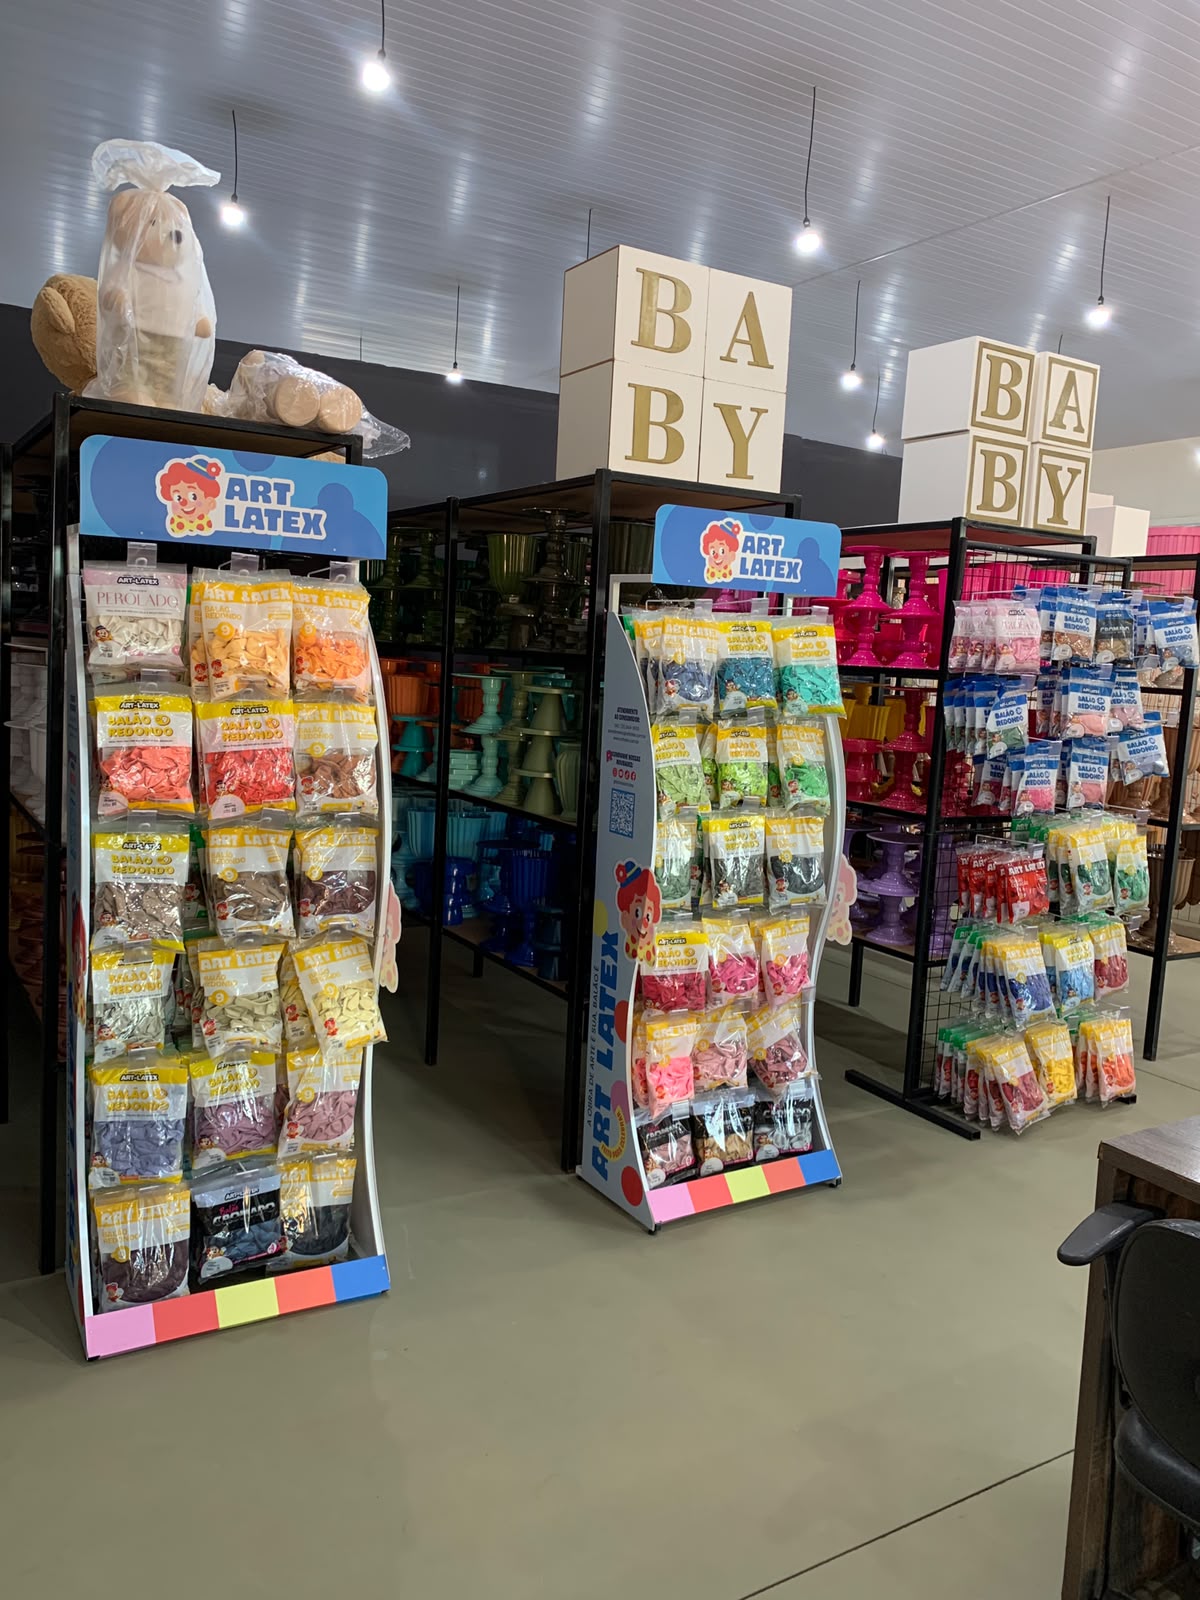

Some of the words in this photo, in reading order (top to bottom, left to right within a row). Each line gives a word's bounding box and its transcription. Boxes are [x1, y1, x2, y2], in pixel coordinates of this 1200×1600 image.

[225, 477, 292, 505] ART
[224, 504, 325, 535] LATEX
[741, 535, 783, 556] ART
[739, 557, 801, 580] LATEX
[117, 577, 159, 586] ART-LATEX
[1166, 634, 1194, 644] REDONDO
[120, 702, 160, 710] ART-LATEX
[231, 706, 269, 715] ART-LATEX
[1078, 703, 1106, 712] REDONDO
[108, 712, 152, 726] BALÃO
[108, 727, 174, 738] REDONDO
[222, 730, 284, 743] REDONDO
[1128, 745, 1159, 756] REDONDO
[210, 835, 239, 846] ART
[111, 865, 175, 875] REDONDO
[1008, 865, 1024, 876] ART
[200, 956, 232, 971] ART
[303, 950, 332, 968] ART
[596, 930, 619, 1071] LATEX
[588, 1046, 596, 1071] ARTE
[120, 1073, 160, 1082] ART-LATEX
[592, 1084, 611, 1181] ART
